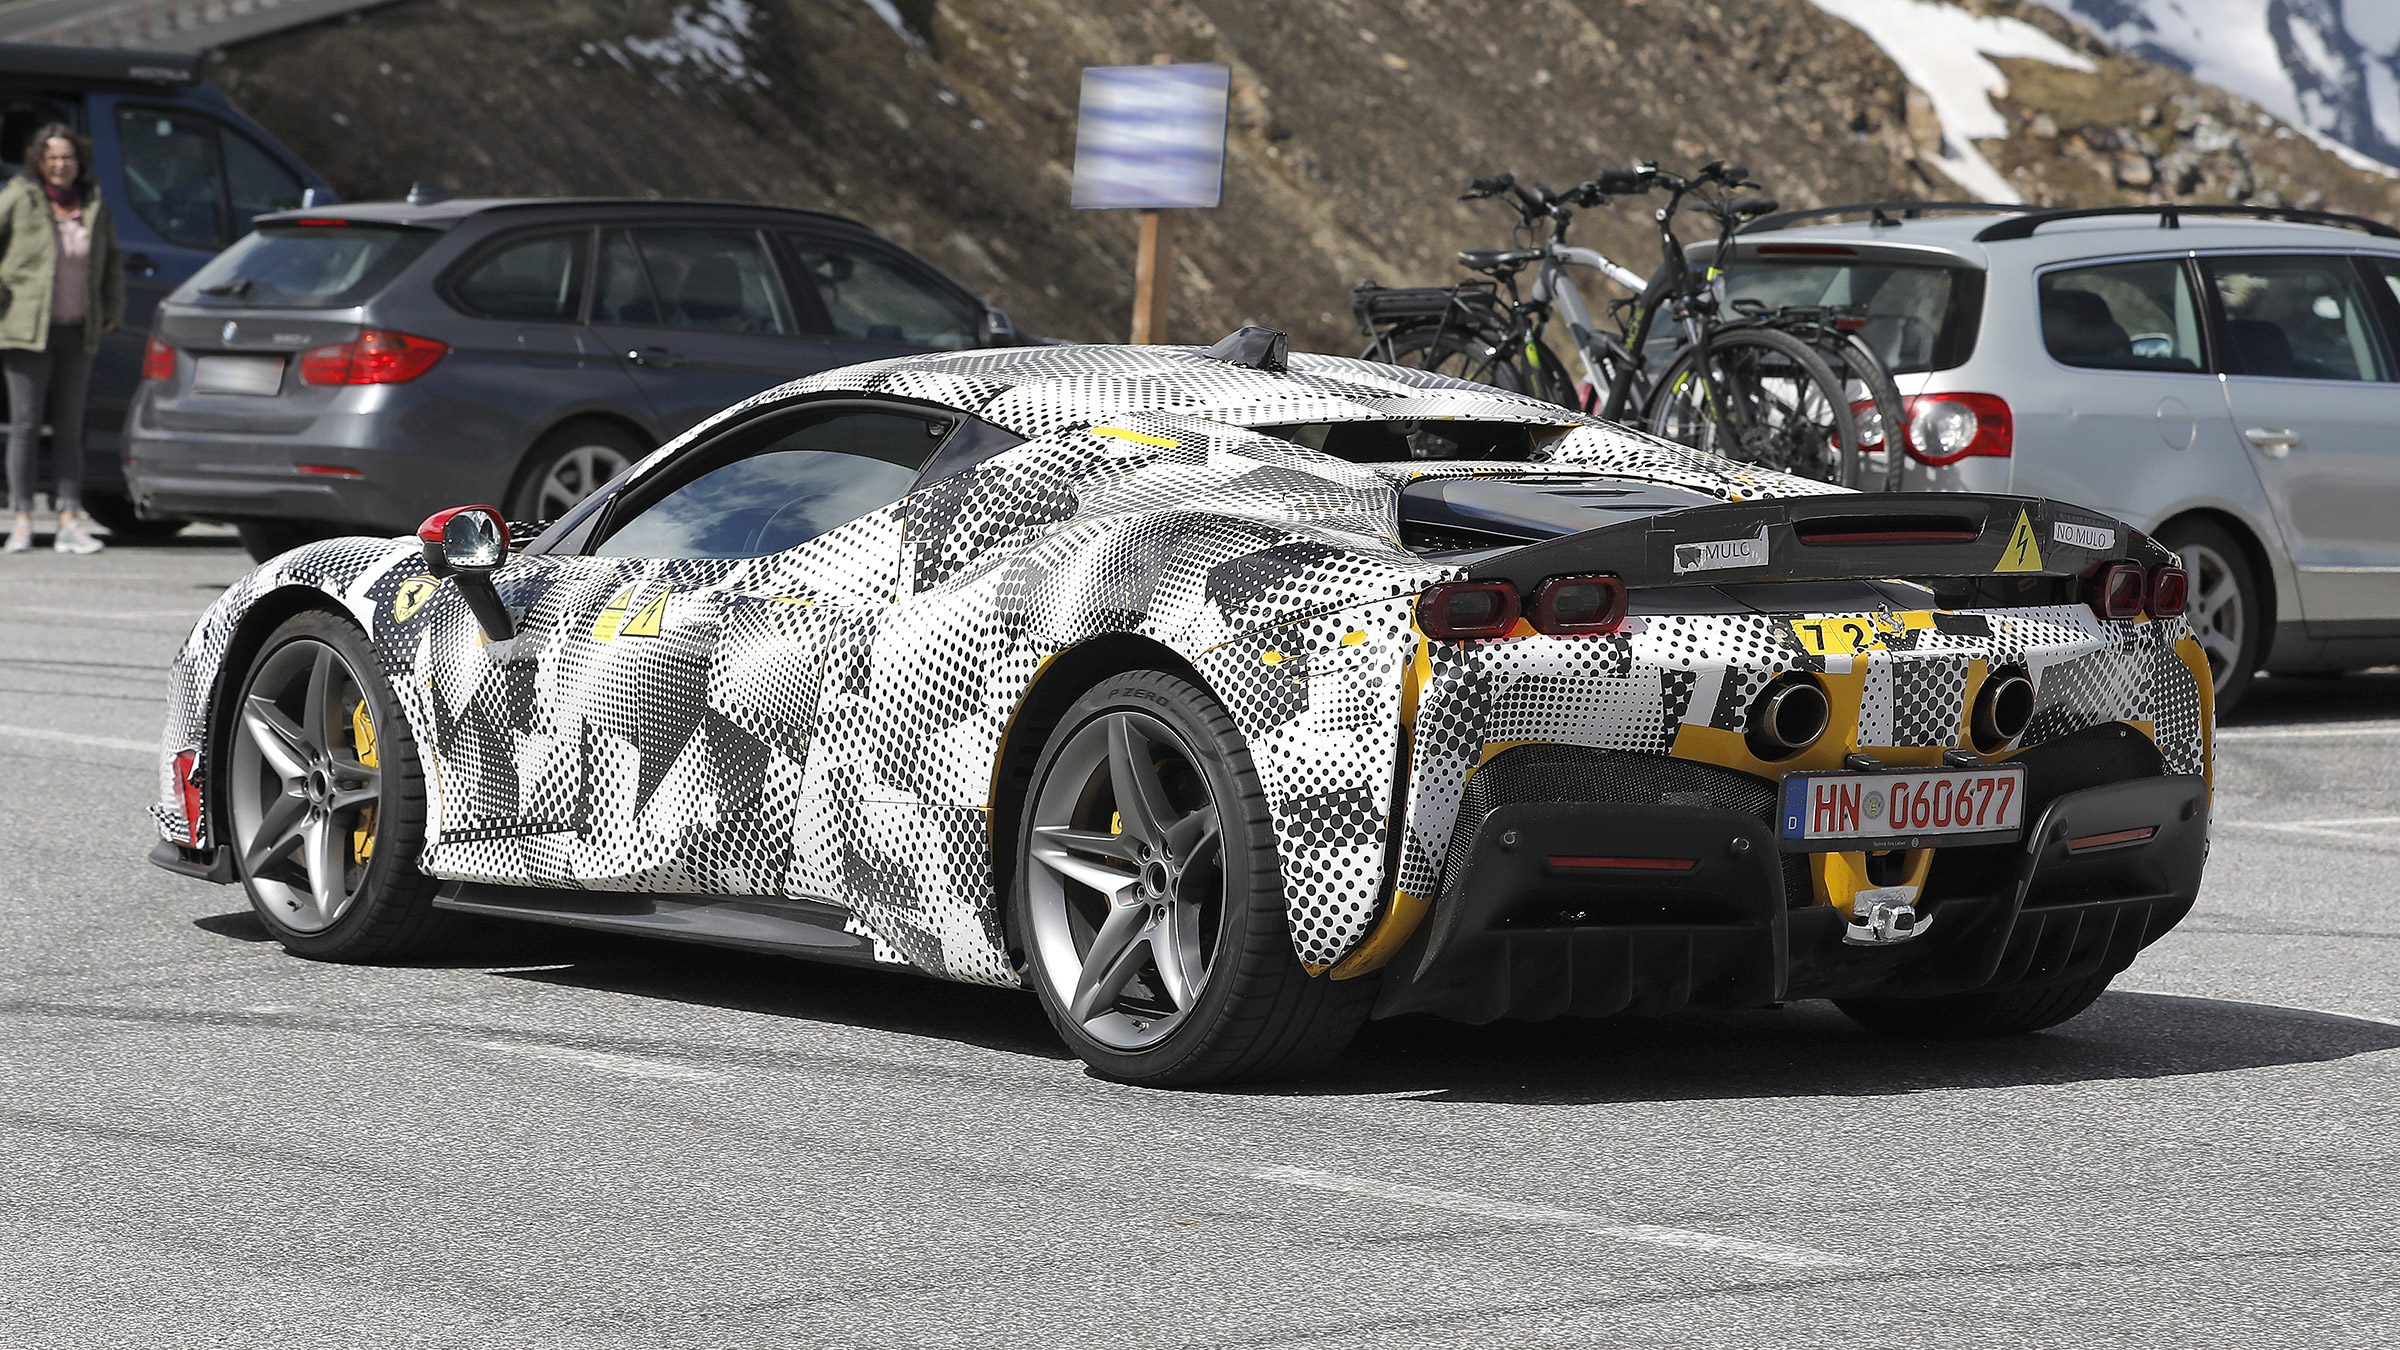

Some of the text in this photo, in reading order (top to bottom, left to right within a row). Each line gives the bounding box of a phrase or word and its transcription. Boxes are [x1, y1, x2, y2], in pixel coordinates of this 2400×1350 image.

[2056, 524, 2106, 548] NO MULO
[1107, 687, 1170, 707] P ZERO
[1813, 776, 2015, 832] HN 060677
[1788, 816, 1797, 830] D
